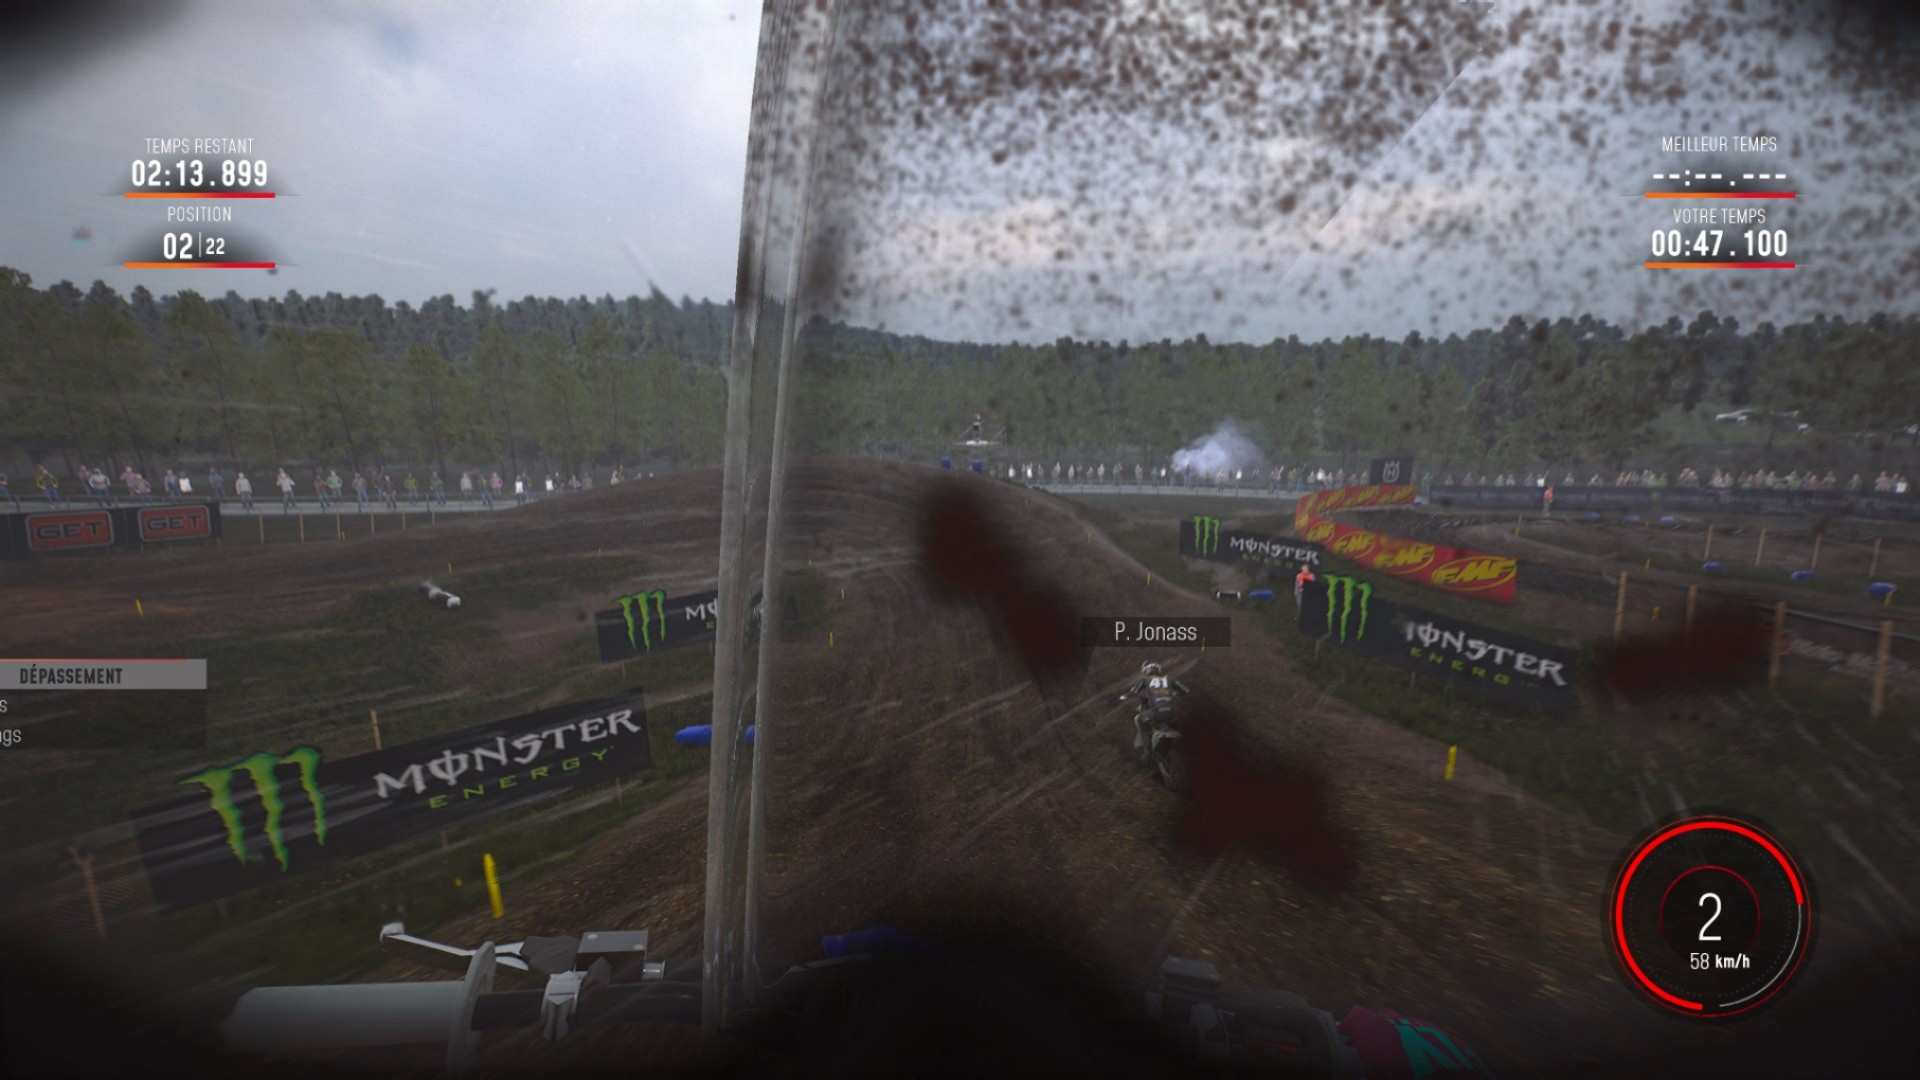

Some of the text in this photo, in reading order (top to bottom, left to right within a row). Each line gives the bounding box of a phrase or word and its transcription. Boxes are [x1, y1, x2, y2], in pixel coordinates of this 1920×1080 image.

[36, 515, 203, 540] GET GET
[1230, 536, 1320, 566] MONSTER
[1432, 559, 1518, 586] FMF
[1410, 647, 1514, 686] ENERG
[1149, 677, 1168, 689] 41
[373, 709, 641, 798] MONSTER
[429, 749, 608, 809] ENERGY
